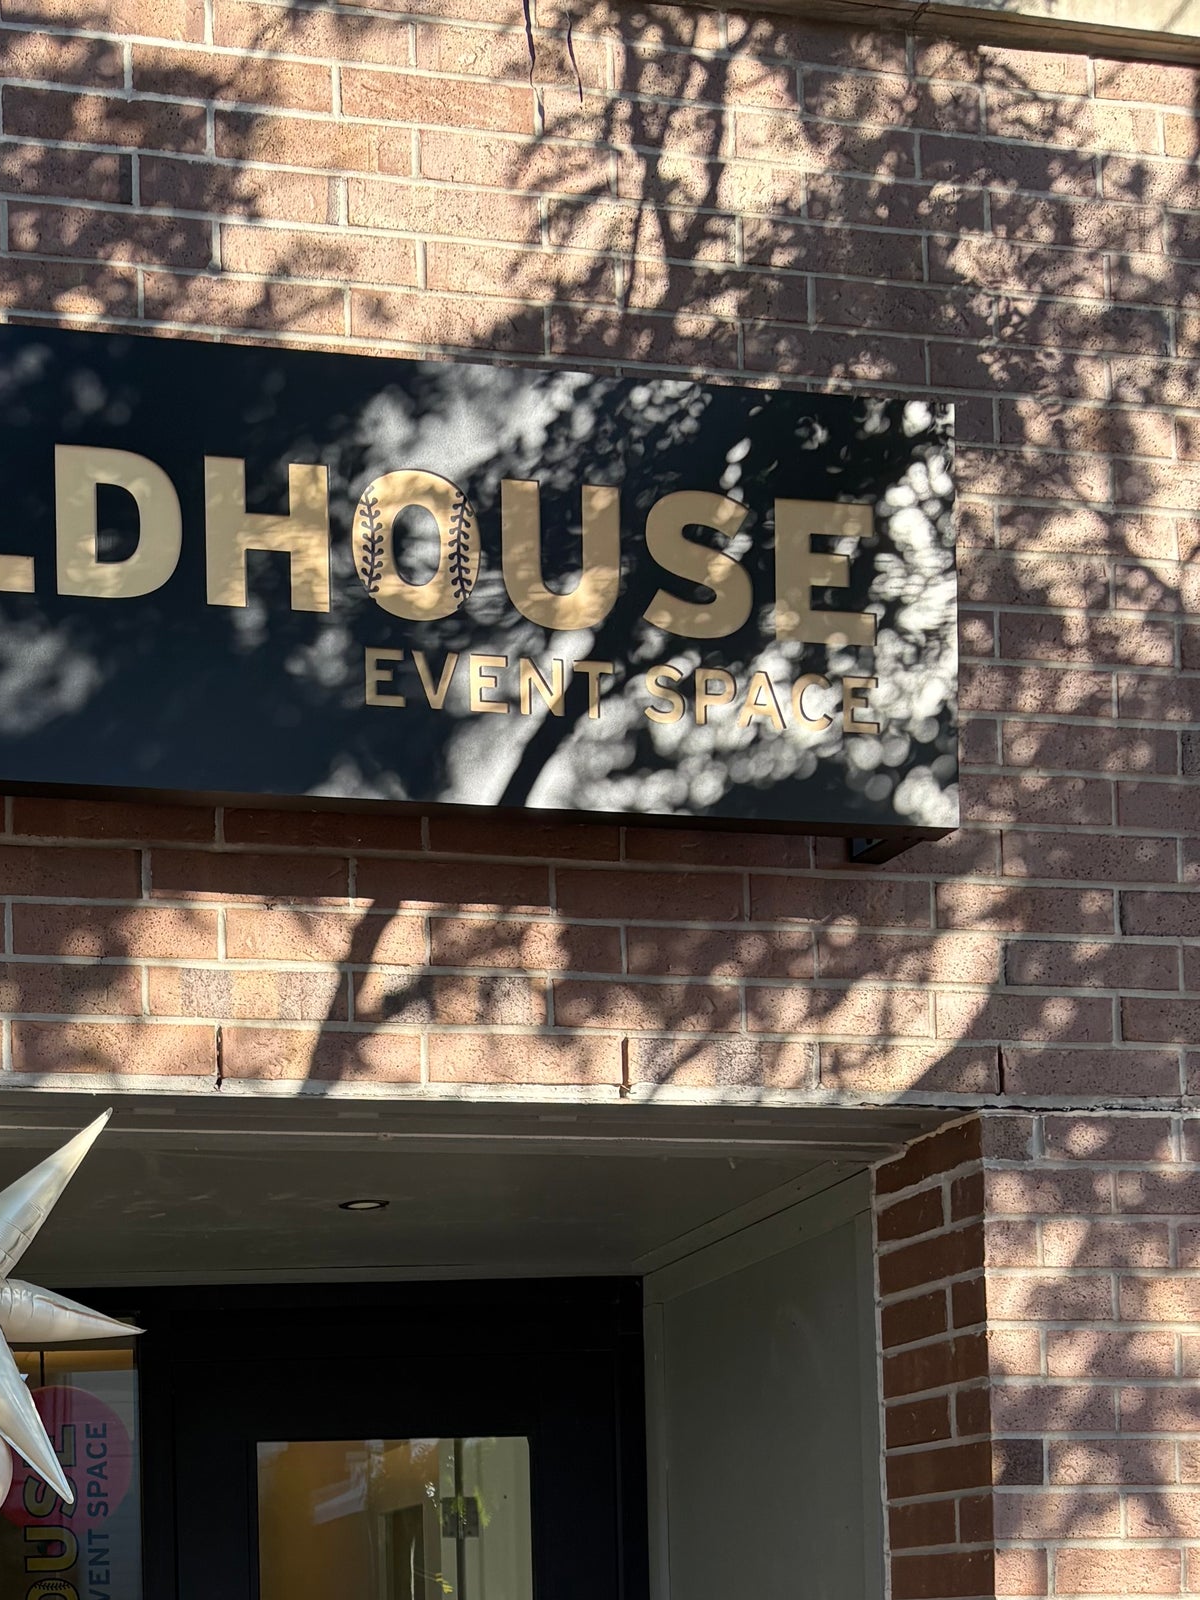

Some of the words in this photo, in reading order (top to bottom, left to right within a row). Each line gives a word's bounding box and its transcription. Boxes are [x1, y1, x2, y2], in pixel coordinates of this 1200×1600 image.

[364, 647, 616, 720] EVENT
[643, 664, 882, 735] SPACE
[85, 1422, 110, 1518] SPACE
